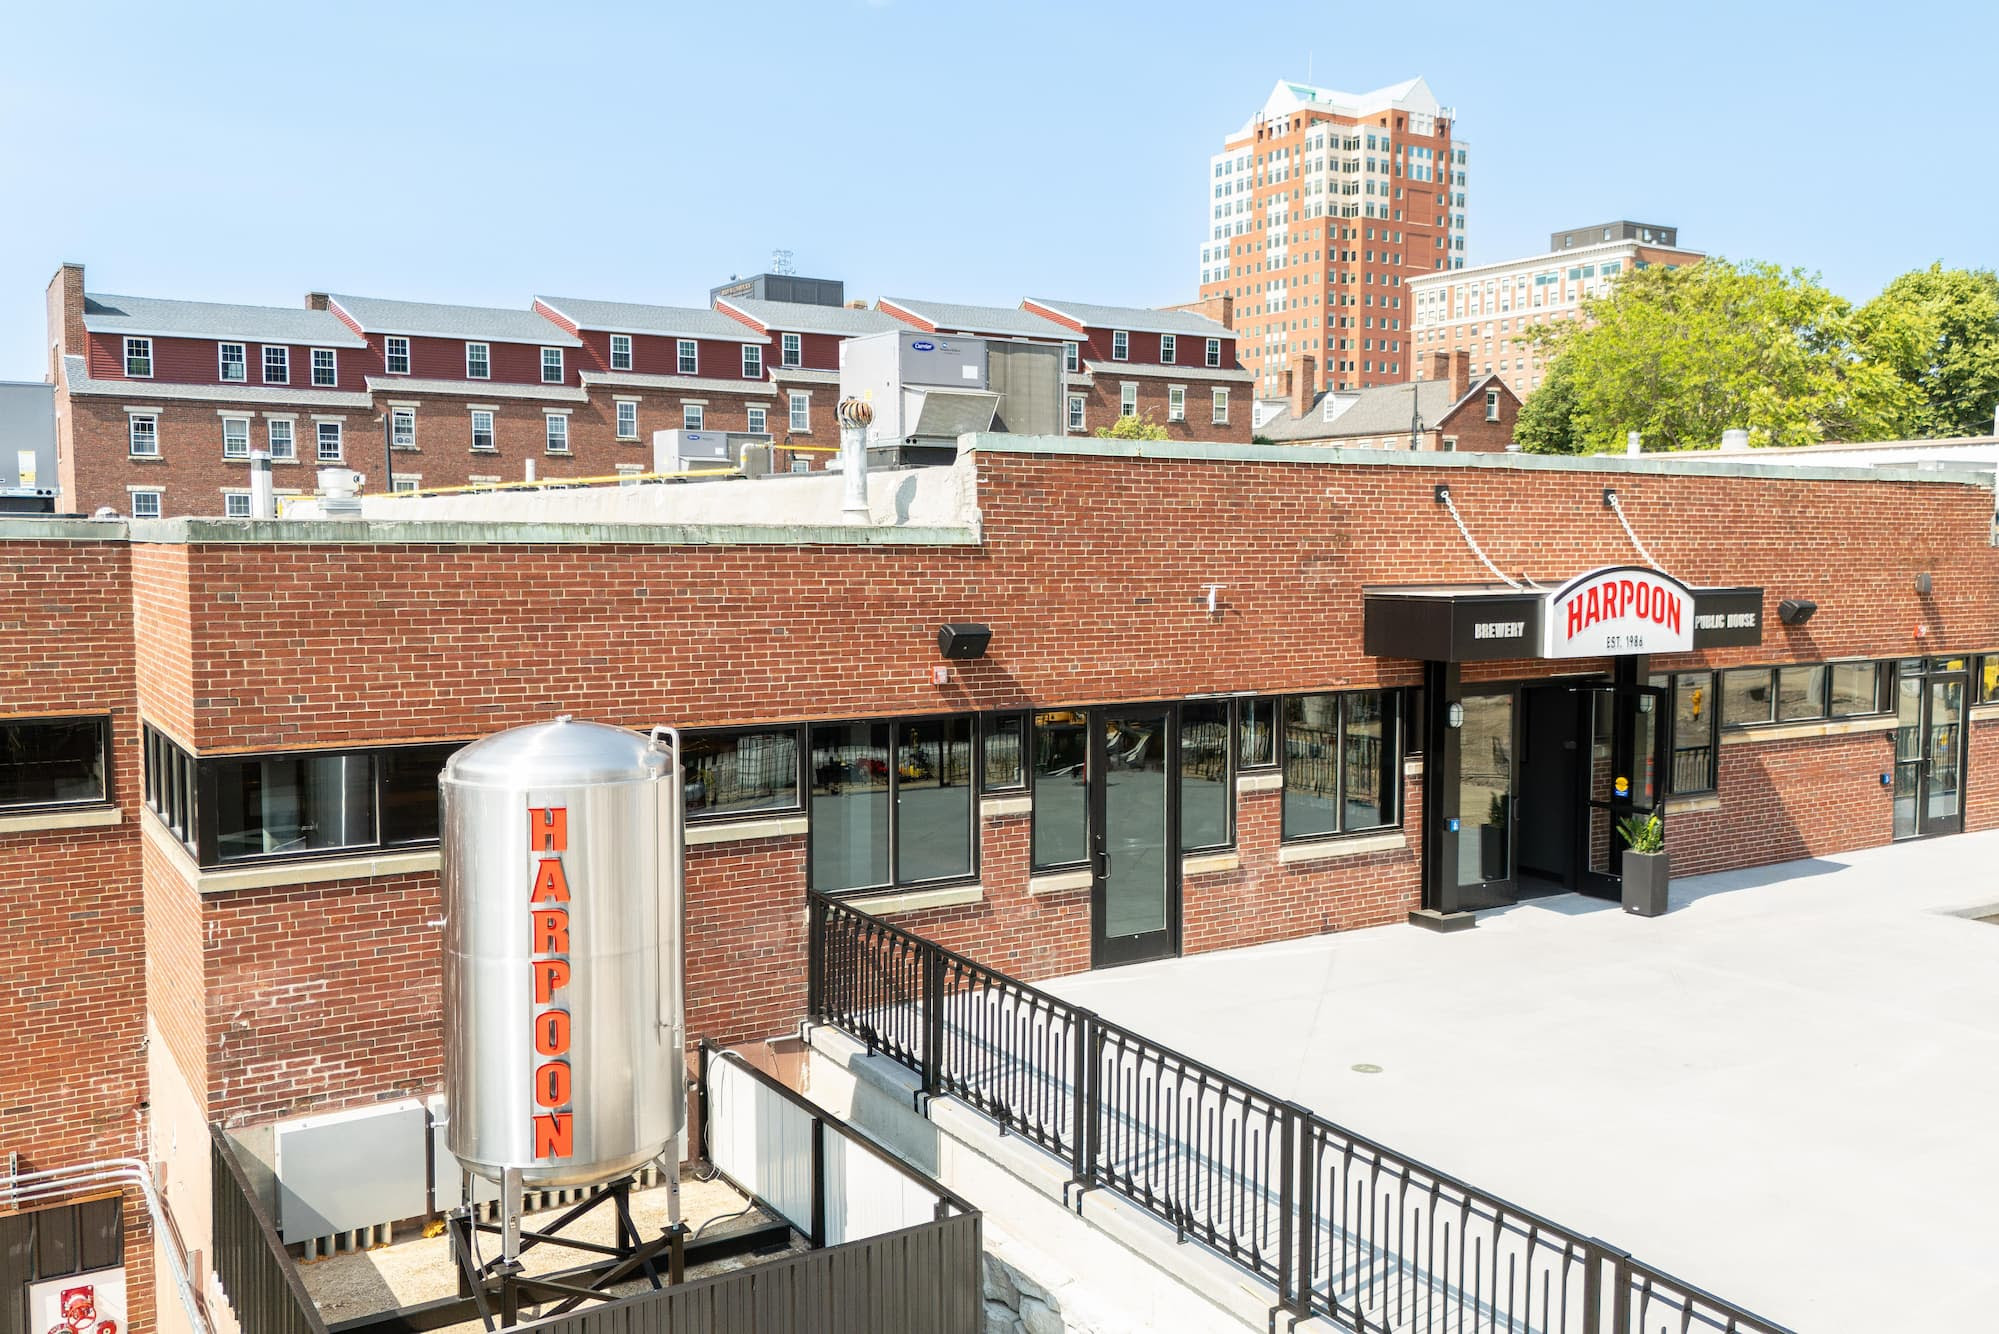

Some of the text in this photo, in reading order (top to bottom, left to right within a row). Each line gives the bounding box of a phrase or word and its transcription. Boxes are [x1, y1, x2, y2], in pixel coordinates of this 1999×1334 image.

[1567, 580, 1681, 640] HARPOON
[1474, 621, 1525, 639] BREWERY
[1694, 613, 1756, 630] PUBLIC HOUSE
[1606, 635, 1643, 648] EST. 1986
[528, 807, 573, 1159] HARPOON
